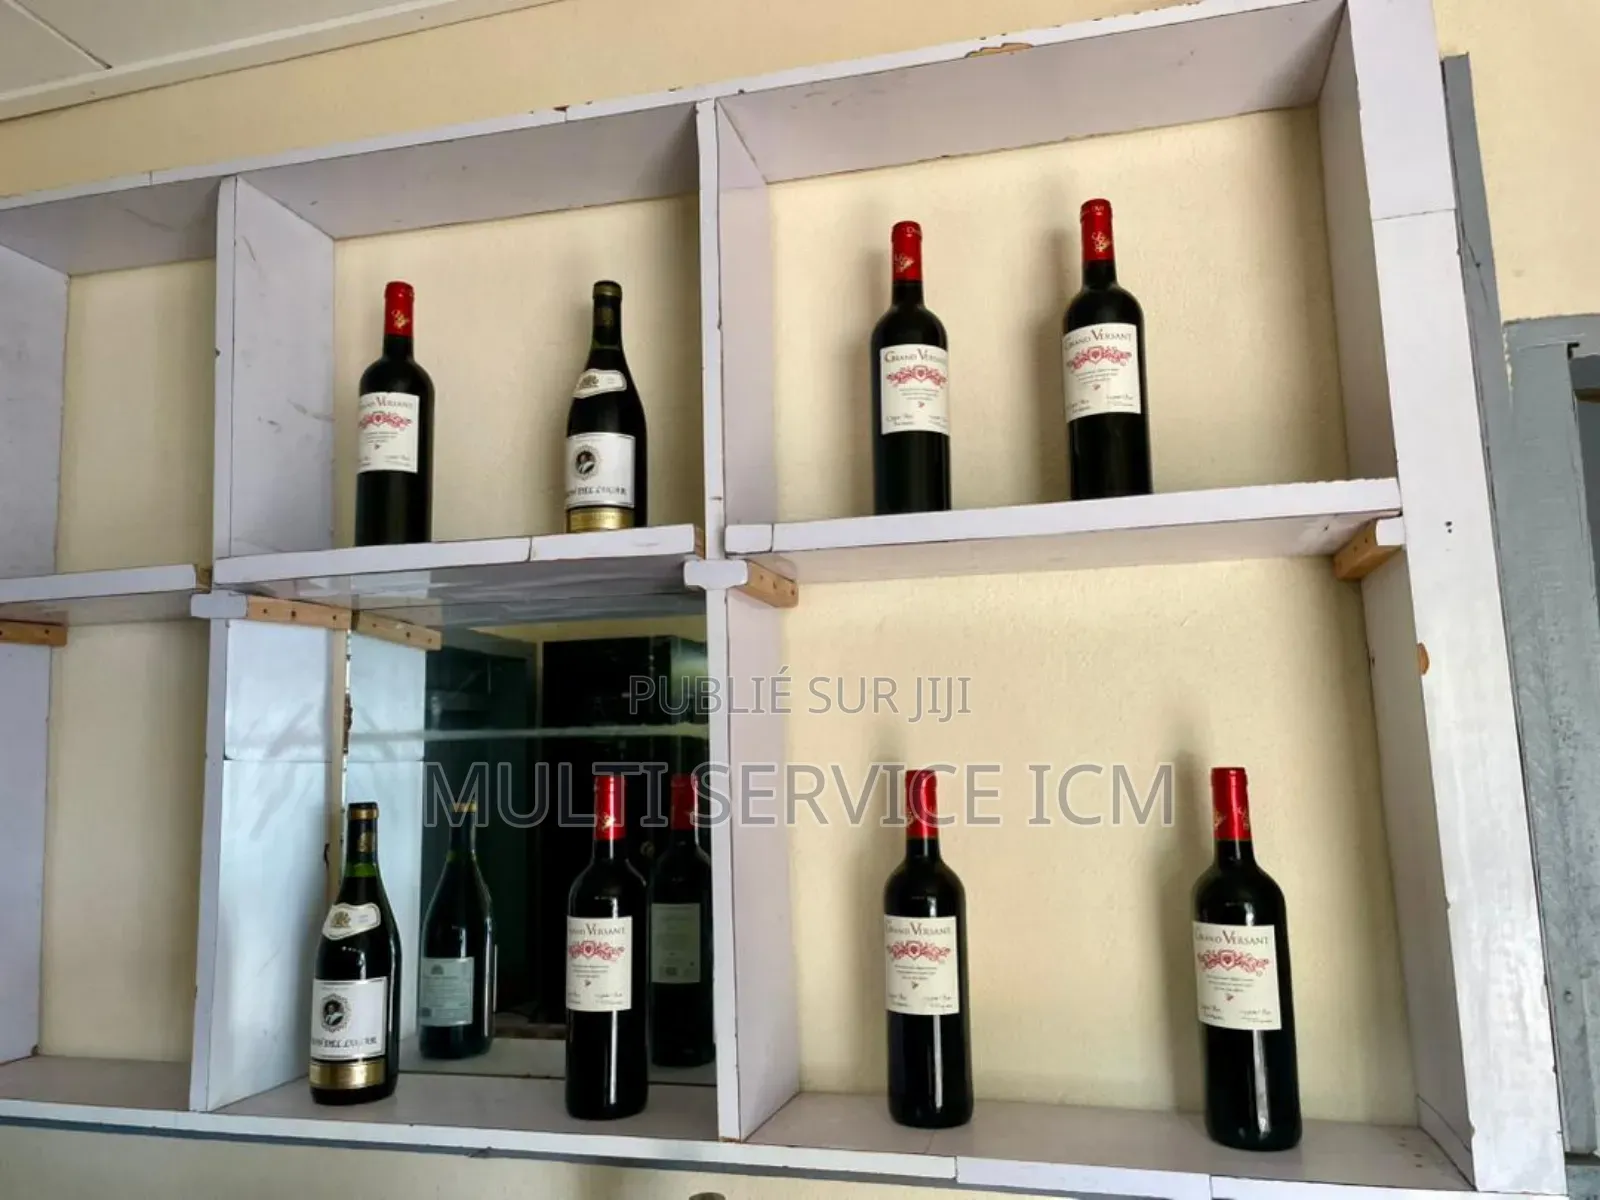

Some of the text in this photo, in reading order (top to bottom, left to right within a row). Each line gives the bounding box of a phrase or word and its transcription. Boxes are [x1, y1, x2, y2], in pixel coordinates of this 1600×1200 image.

[884, 350, 918, 363] GRAND
[909, 922, 951, 936] VERSANT
[1222, 930, 1269, 946] VERSANT
